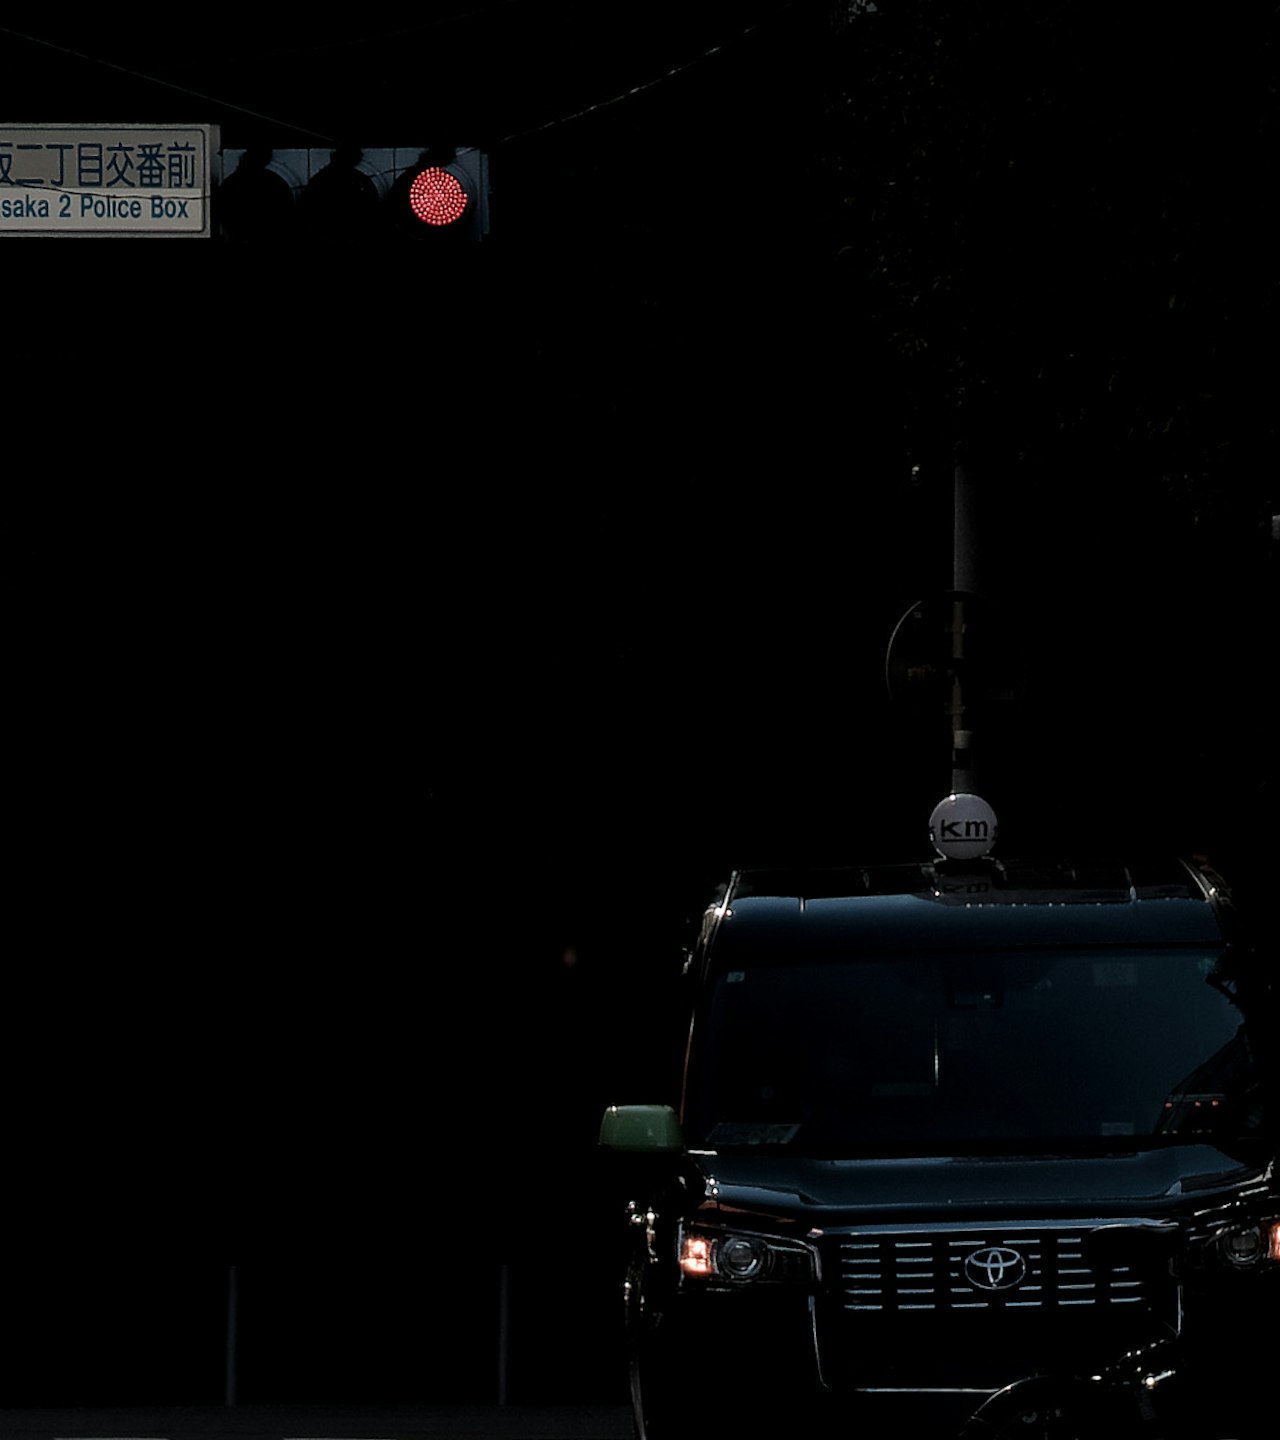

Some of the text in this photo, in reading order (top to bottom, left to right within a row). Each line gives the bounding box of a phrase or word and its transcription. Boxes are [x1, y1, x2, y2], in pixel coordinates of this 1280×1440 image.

[59, 195, 72, 218] 2
[80, 194, 142, 218] Police
[151, 195, 190, 218] Box
[941, 819, 988, 837] km
